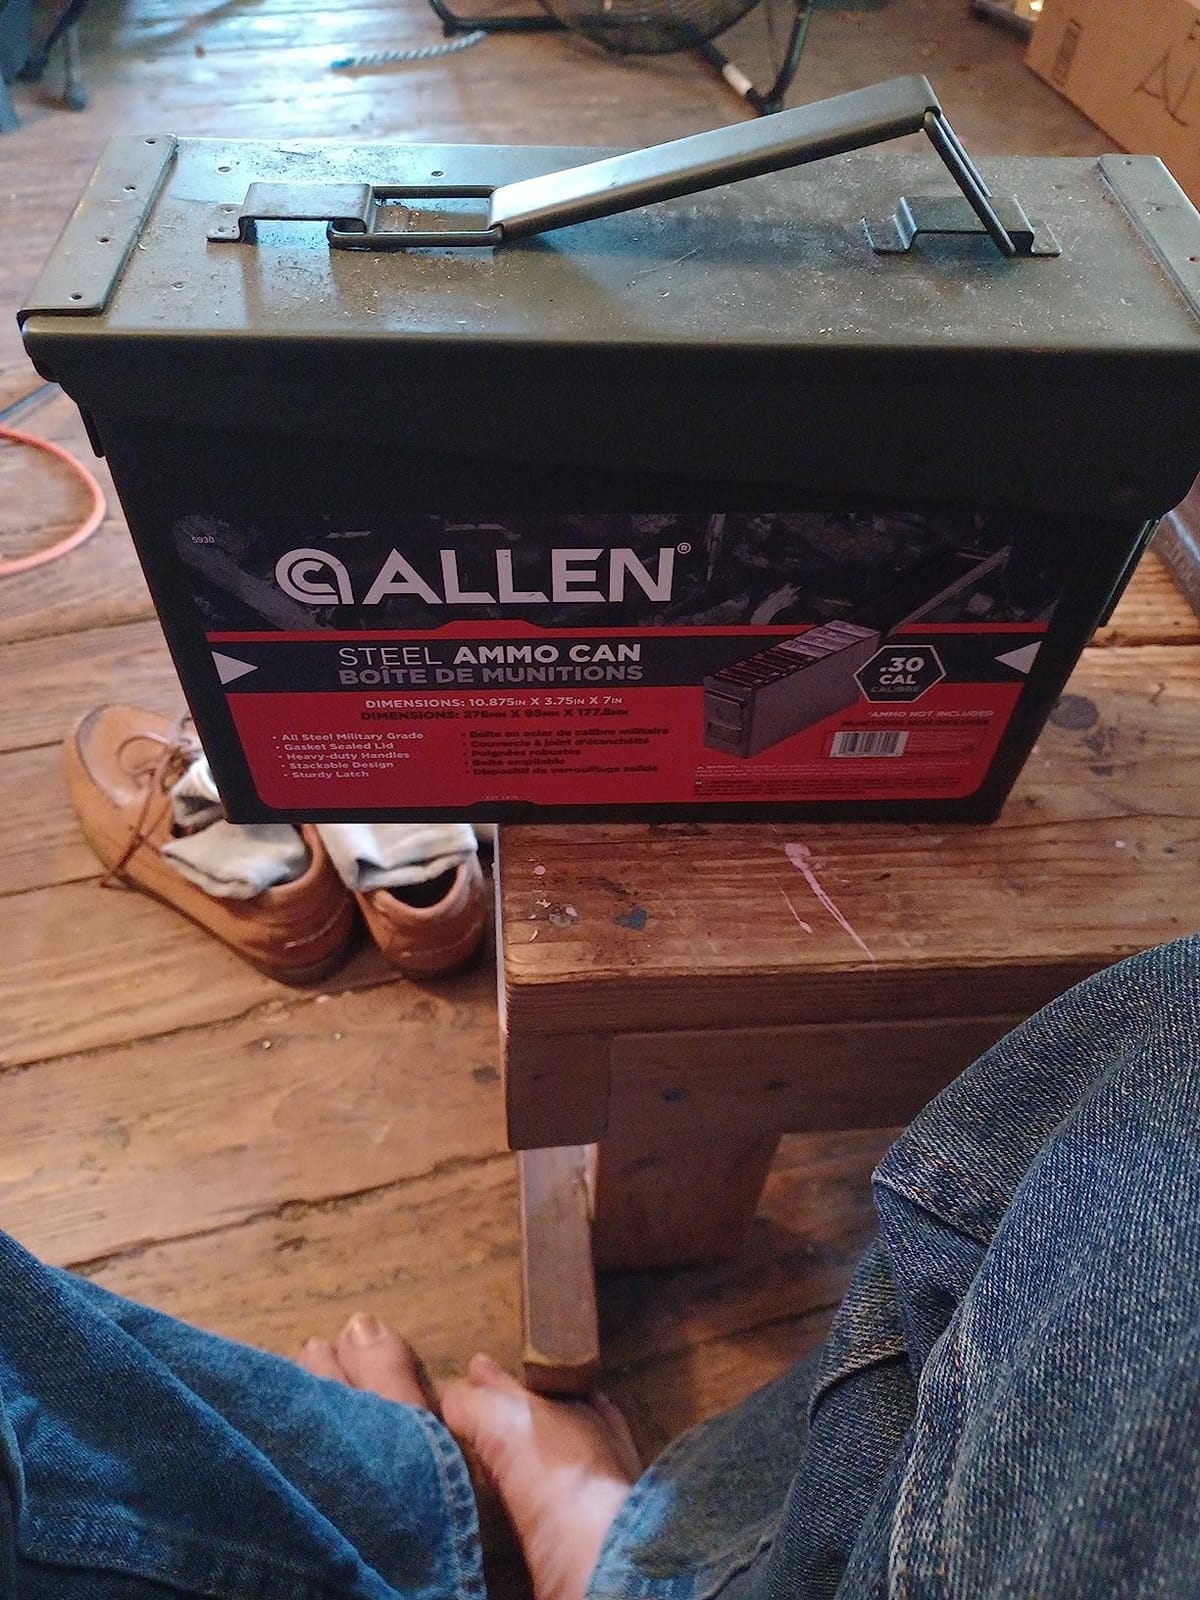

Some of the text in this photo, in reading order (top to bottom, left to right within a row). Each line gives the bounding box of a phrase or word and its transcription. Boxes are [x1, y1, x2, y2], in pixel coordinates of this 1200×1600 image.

[362, 548, 676, 605] ALLEN
[338, 643, 642, 667] STEEL AMMO CAN
[879, 657, 926, 673] .30
[338, 664, 645, 685] BOÎTE DE MUNITIONS
[879, 674, 917, 685] CAL
[365, 698, 466, 709] DIMENSIONS:
[530, 697, 540, 706] X
[588, 696, 598, 705] X
[360, 709, 461, 721] DIMENSIONS:
[510, 708, 520, 718] X
[563, 707, 574, 717] X
[282, 731, 424, 742] All Steel Military Grade
[284, 742, 394, 751] Gasket Sealed Lid
[544, 738, 573, 747] joint
[286, 751, 410, 761] Heavy-duty Handles
[289, 761, 394, 770] Stackable Design
[292, 770, 369, 779] Sturdy Latch
